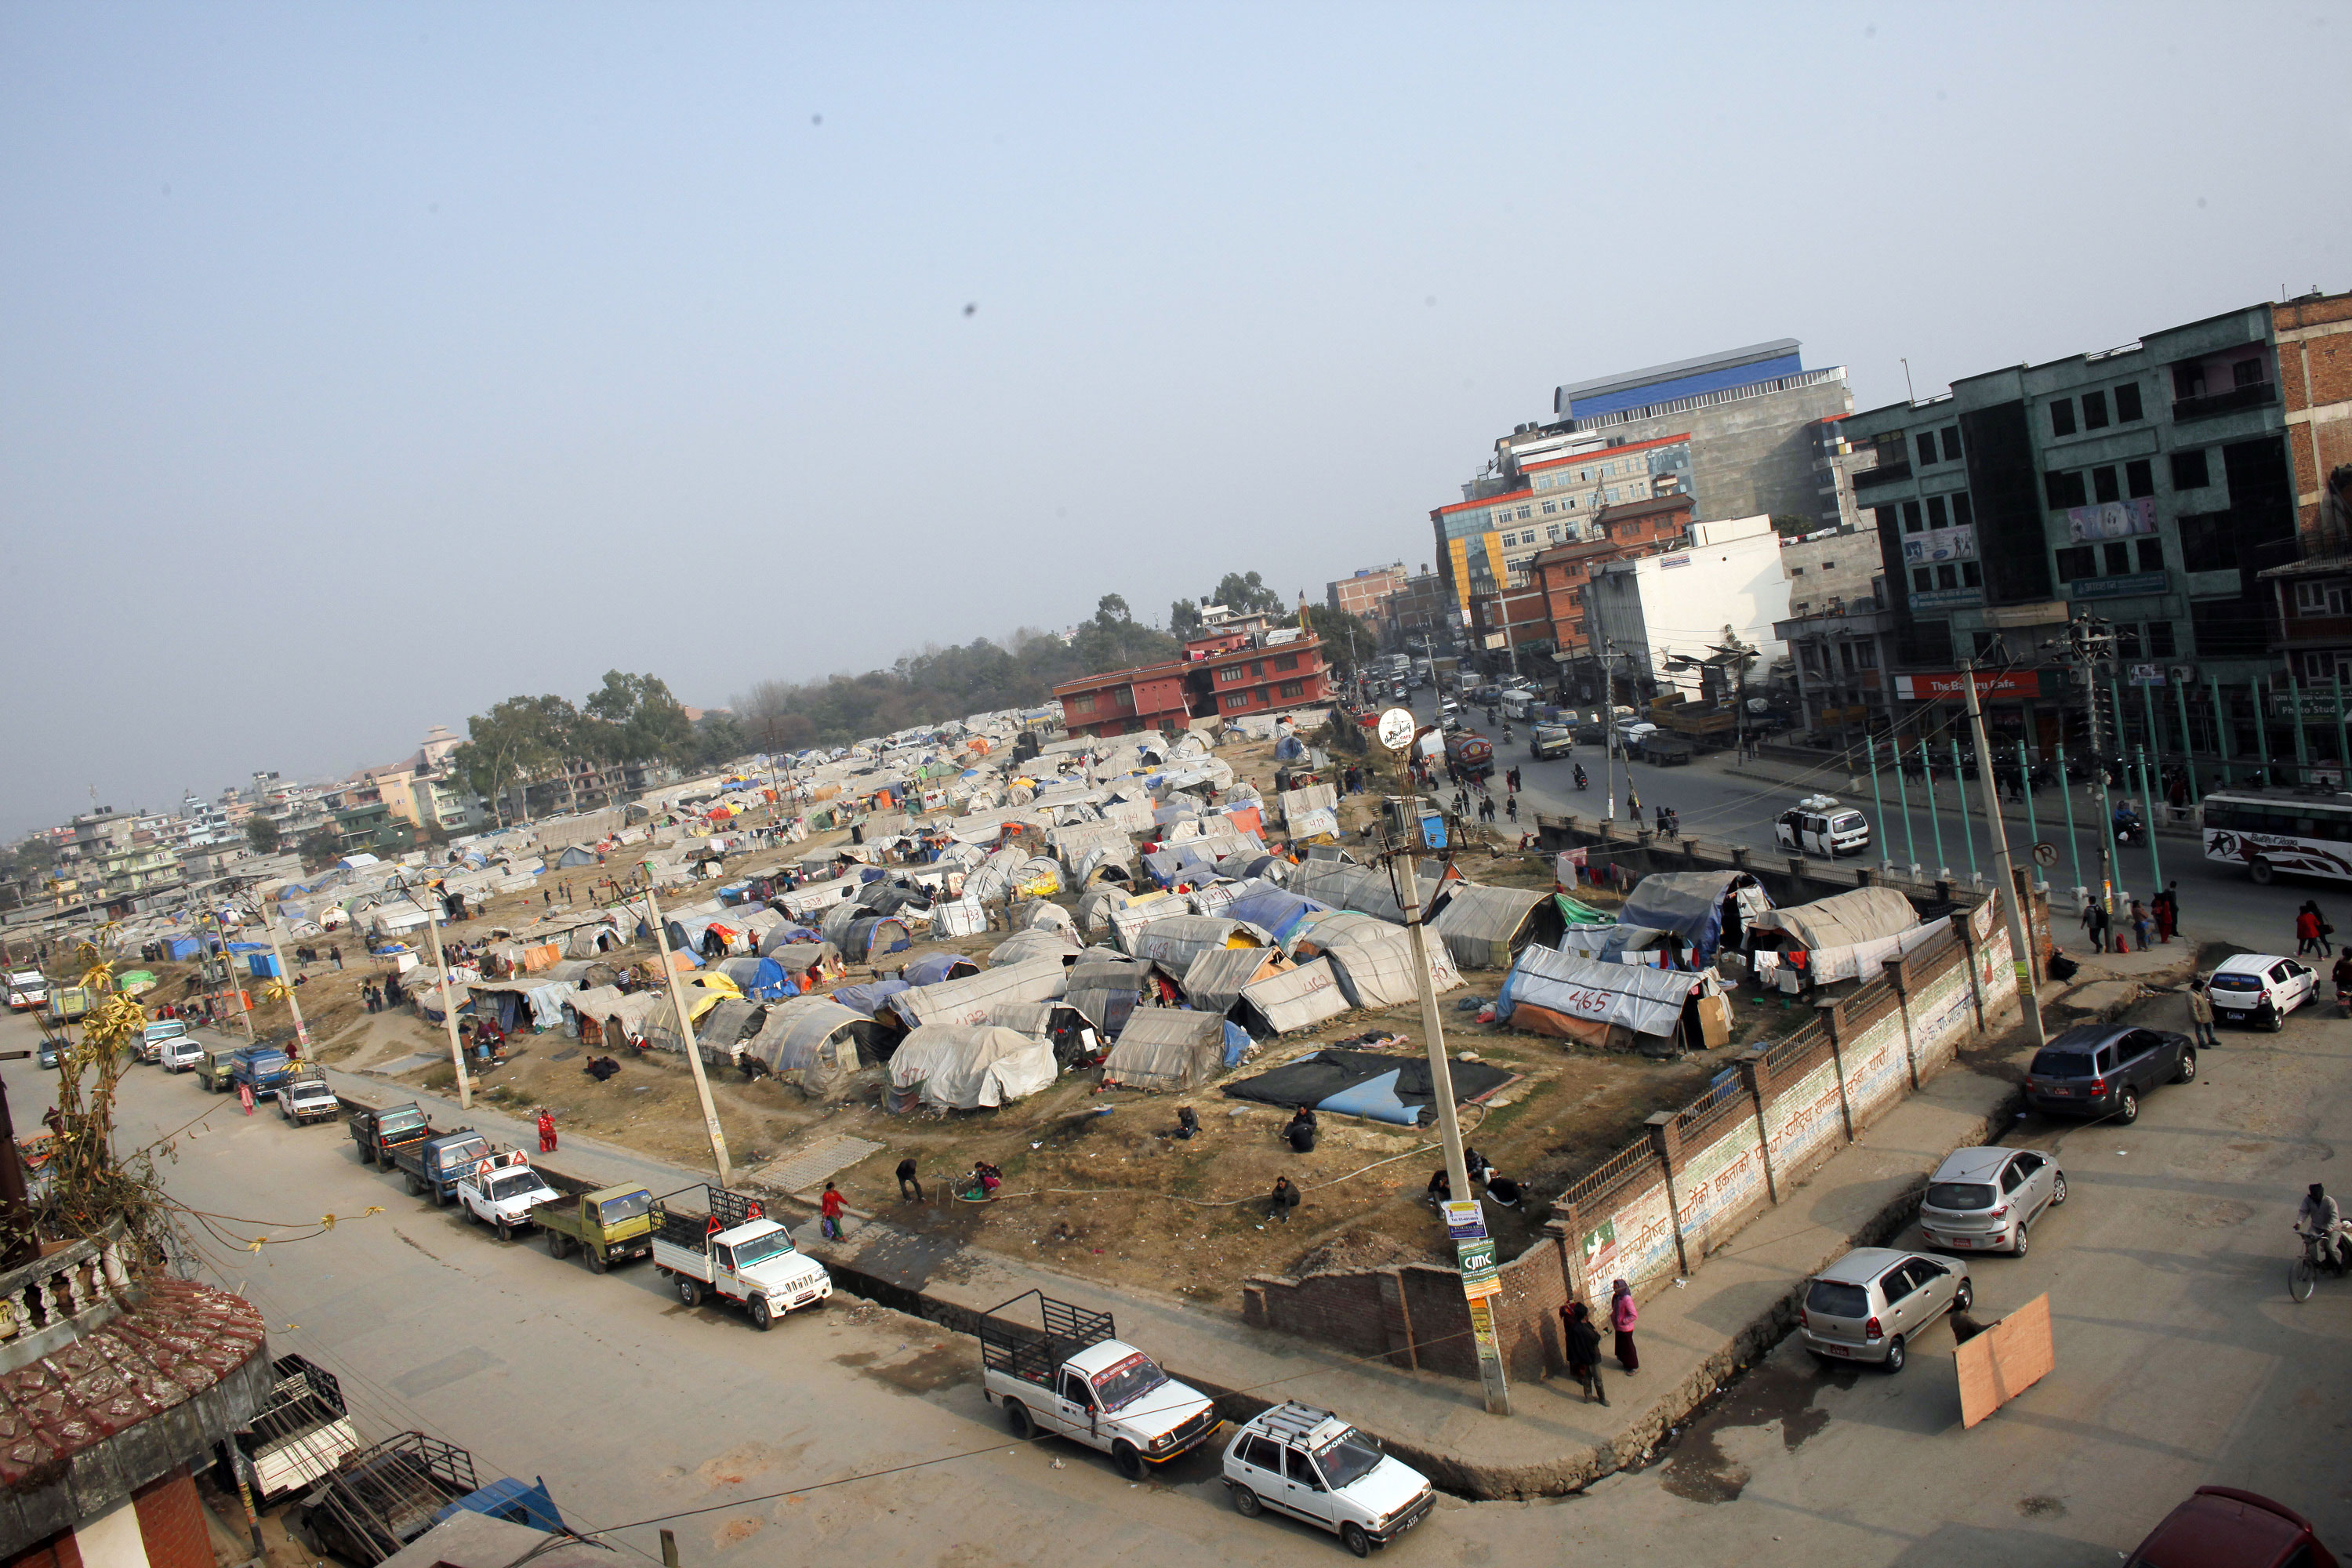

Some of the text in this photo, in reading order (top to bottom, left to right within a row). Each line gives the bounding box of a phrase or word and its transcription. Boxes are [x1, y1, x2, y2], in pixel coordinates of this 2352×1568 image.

[1931, 681, 1951, 691] The
[1951, 681, 1987, 691] Bary
[2249, 833, 2278, 844] Bullet
[962, 909, 980, 923] 433
[1149, 941, 1169, 960] 468
[1303, 974, 1330, 993] 462
[1570, 990, 1612, 1013] 465
[1715, 1150, 1750, 1192] एकताको
[1320, 1430, 1354, 1457] SPORTS
